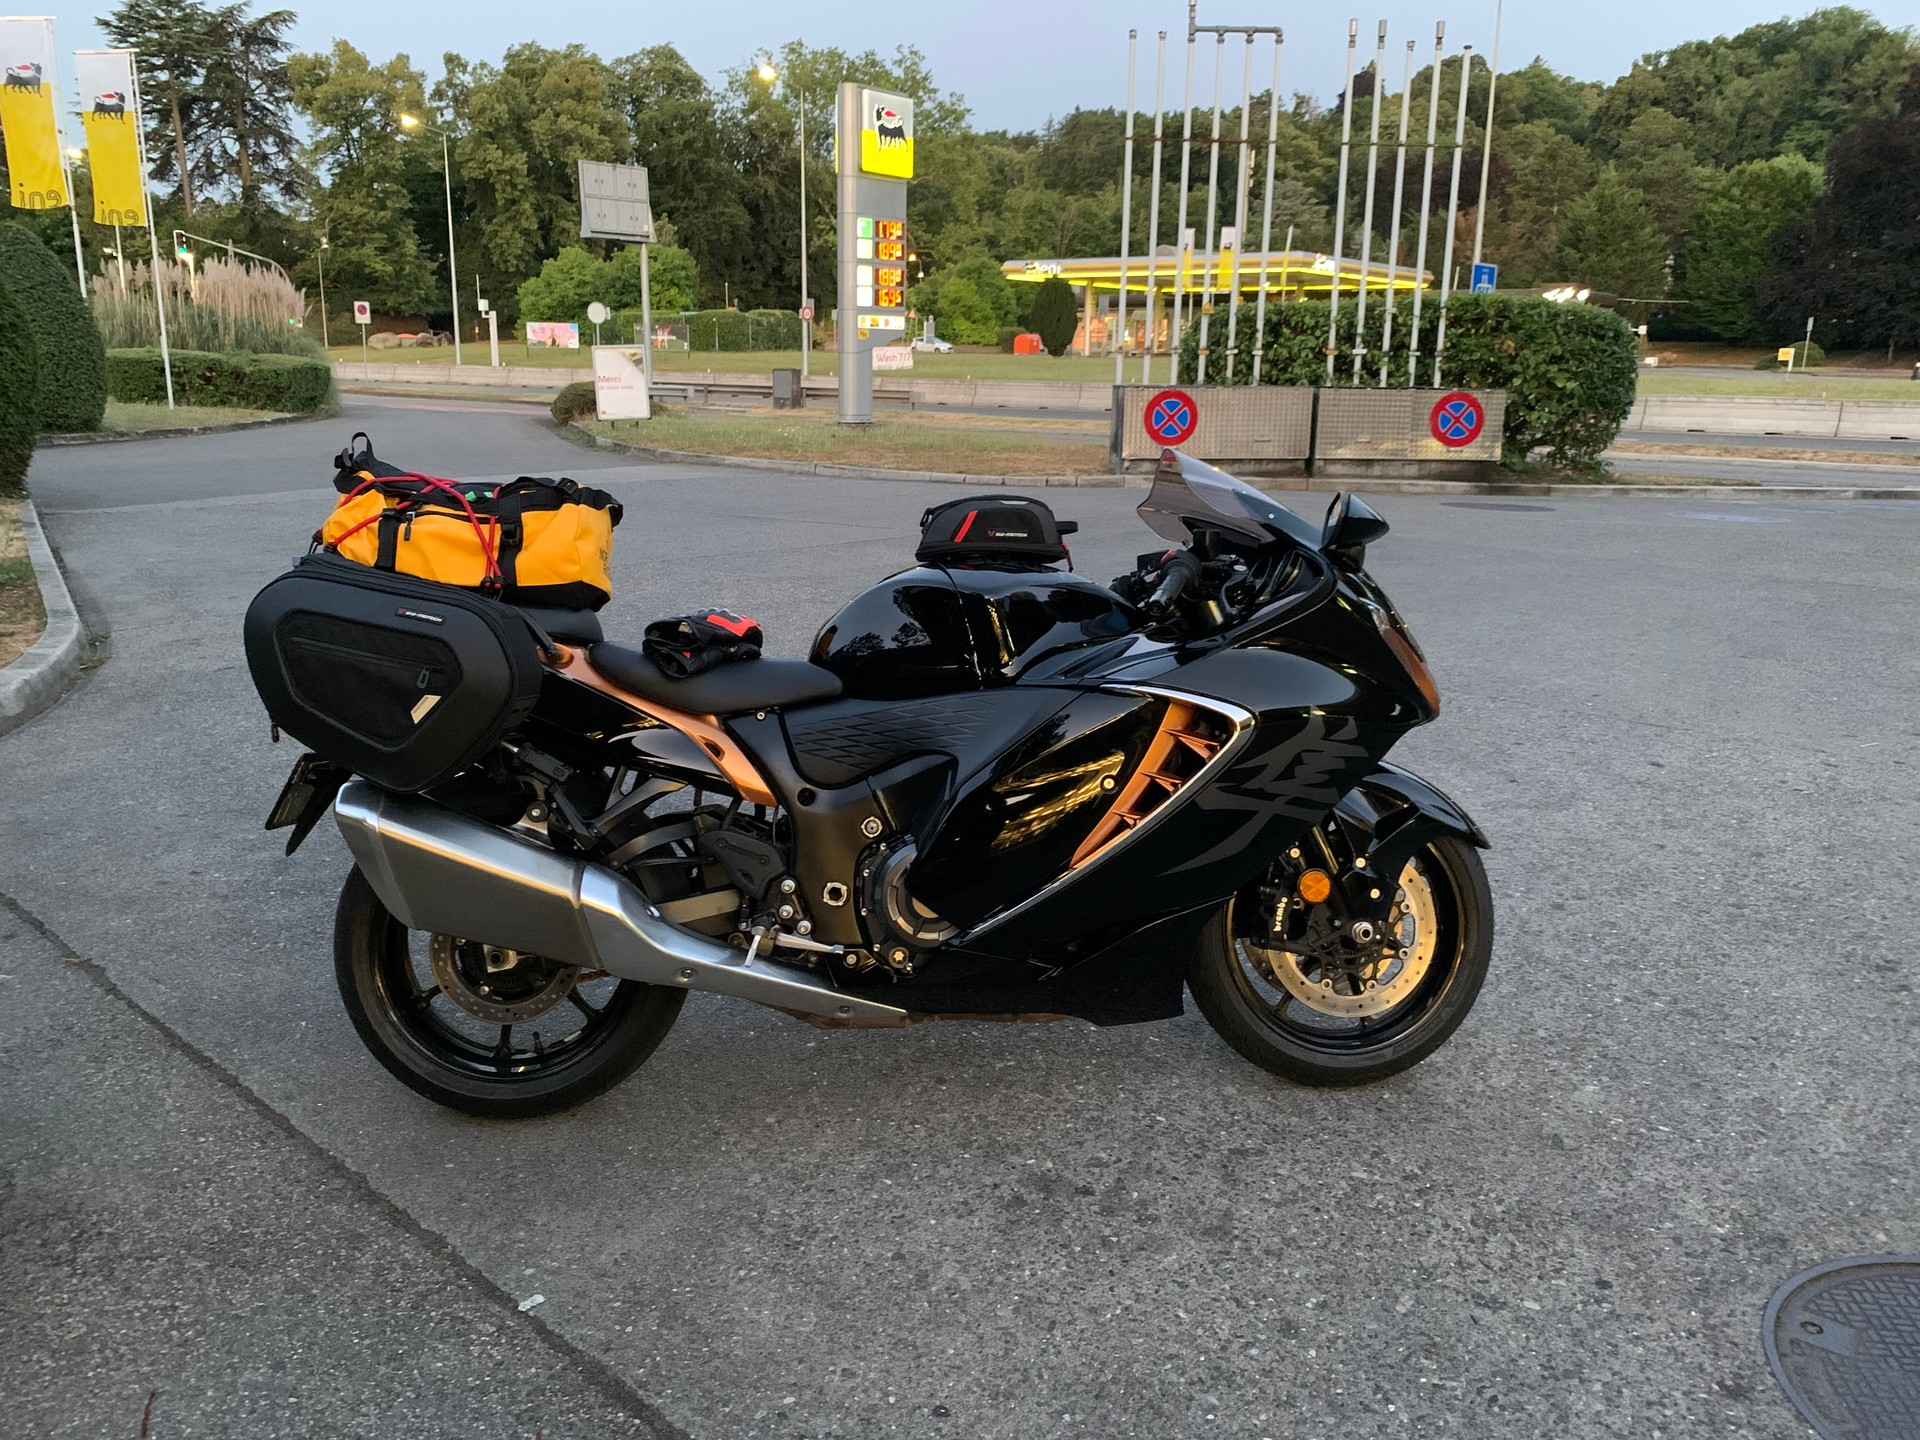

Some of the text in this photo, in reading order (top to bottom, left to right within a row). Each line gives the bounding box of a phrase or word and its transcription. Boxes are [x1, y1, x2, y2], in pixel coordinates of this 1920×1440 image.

[876, 351, 897, 362] Wash
[598, 374, 621, 383] Merci
[1273, 896, 1288, 932] brembo
